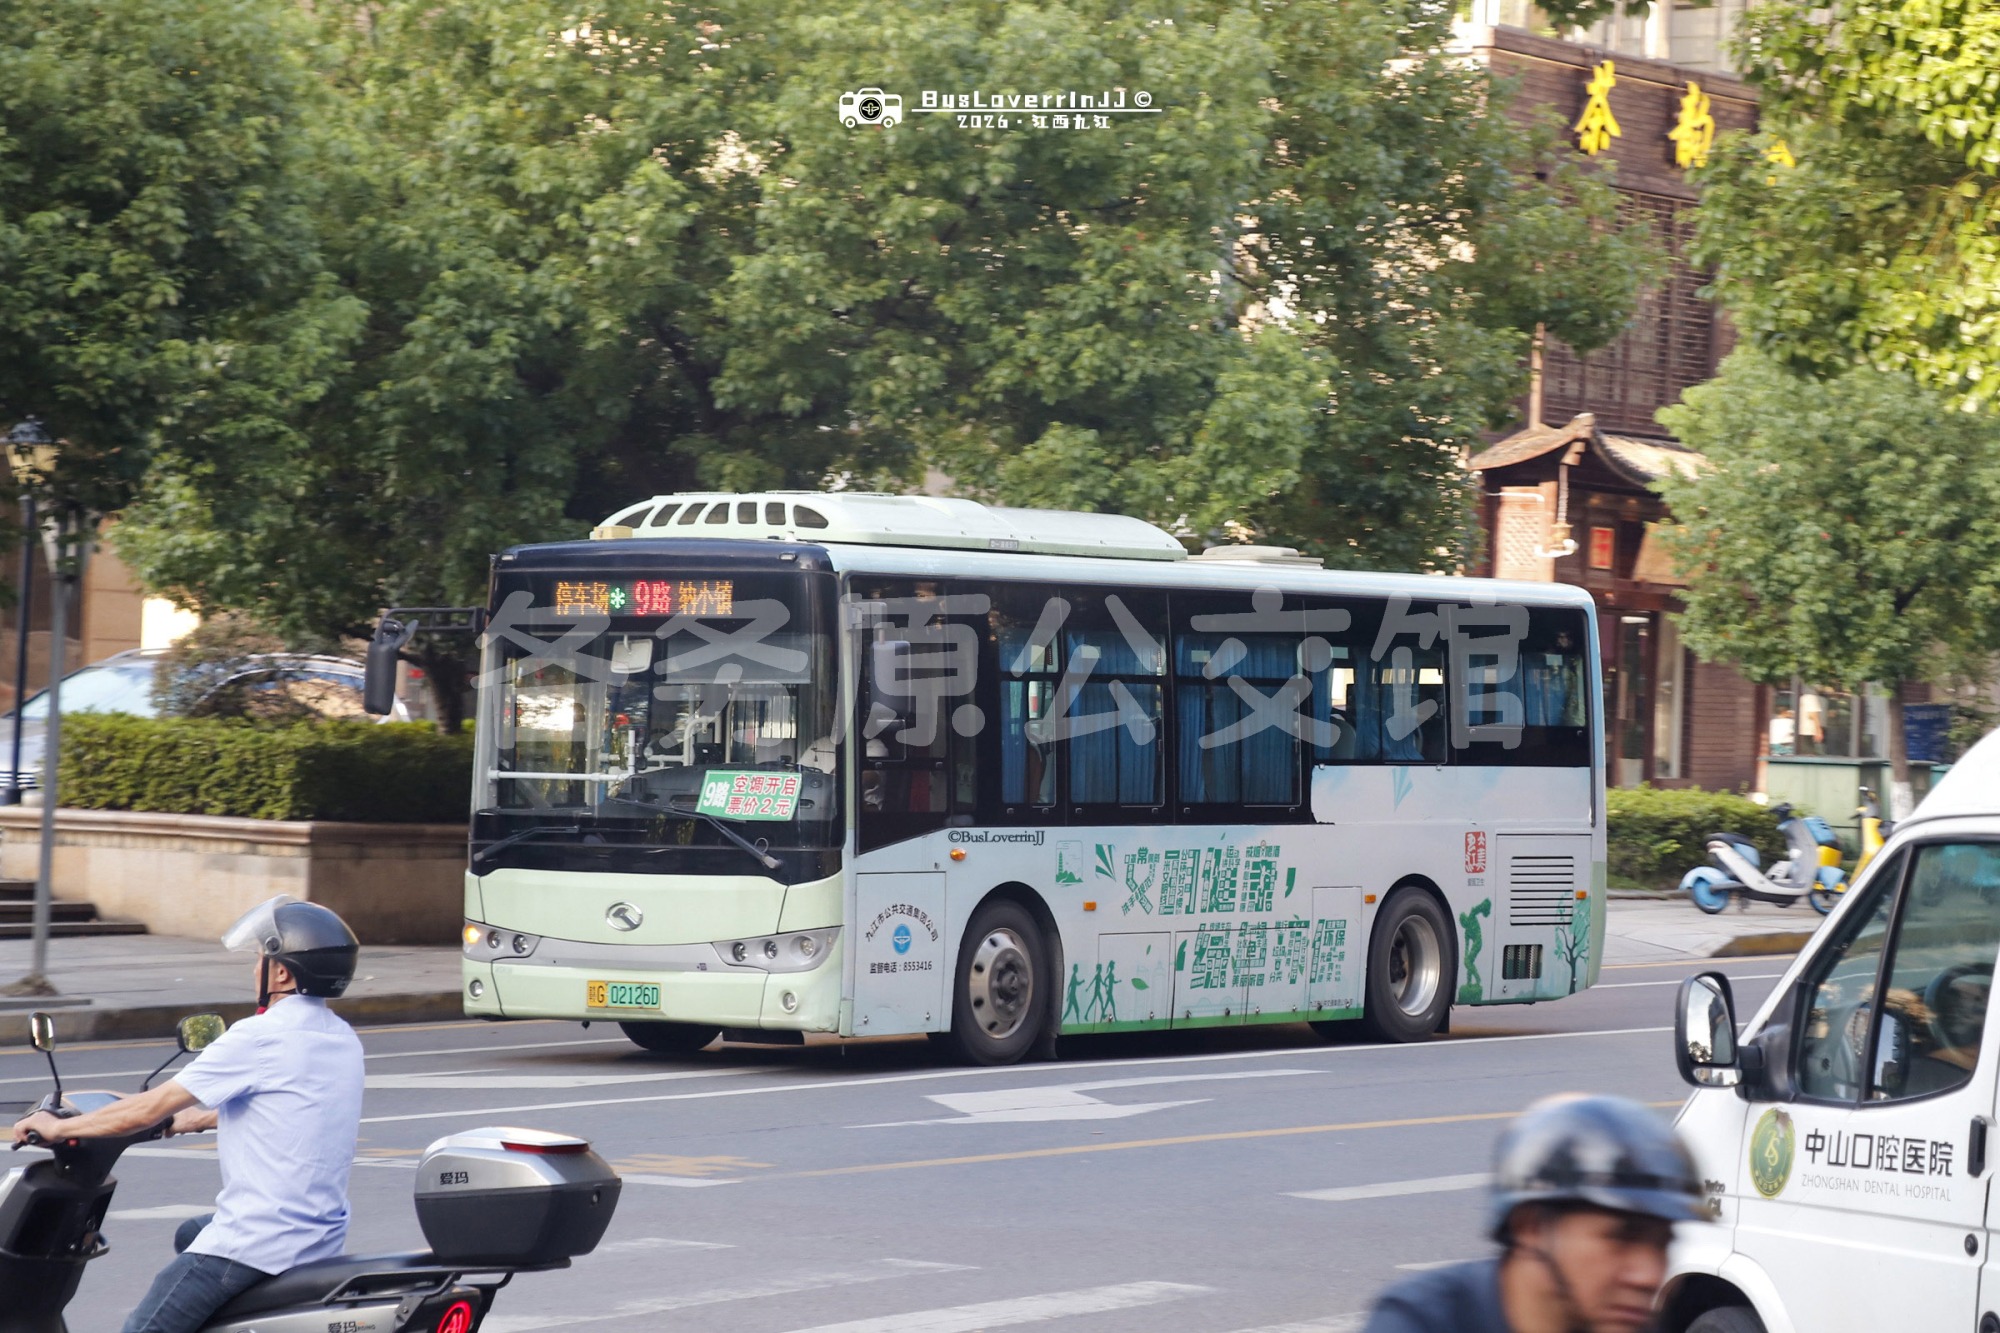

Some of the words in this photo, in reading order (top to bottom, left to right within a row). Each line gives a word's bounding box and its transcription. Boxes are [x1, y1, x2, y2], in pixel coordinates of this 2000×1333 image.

[555, 581, 609, 616] 停车场
[634, 580, 672, 616] 9路
[703, 780, 730, 808] 9路
[732, 774, 798, 797] 空调开启
[725, 796, 792, 817] 票价2元
[865, 903, 939, 943] 九江市公共交通集团公司
[1804, 1127, 1954, 1177] 中山口腔医院
[439, 1171, 469, 1186] 爱玛
[1801, 1174, 1860, 1191] ZHONGSHAN
[1864, 1180, 1900, 1197] DENTAL
[1905, 1185, 1952, 1201] HOSPITAL
[328, 1320, 357, 1333] 爱玛
